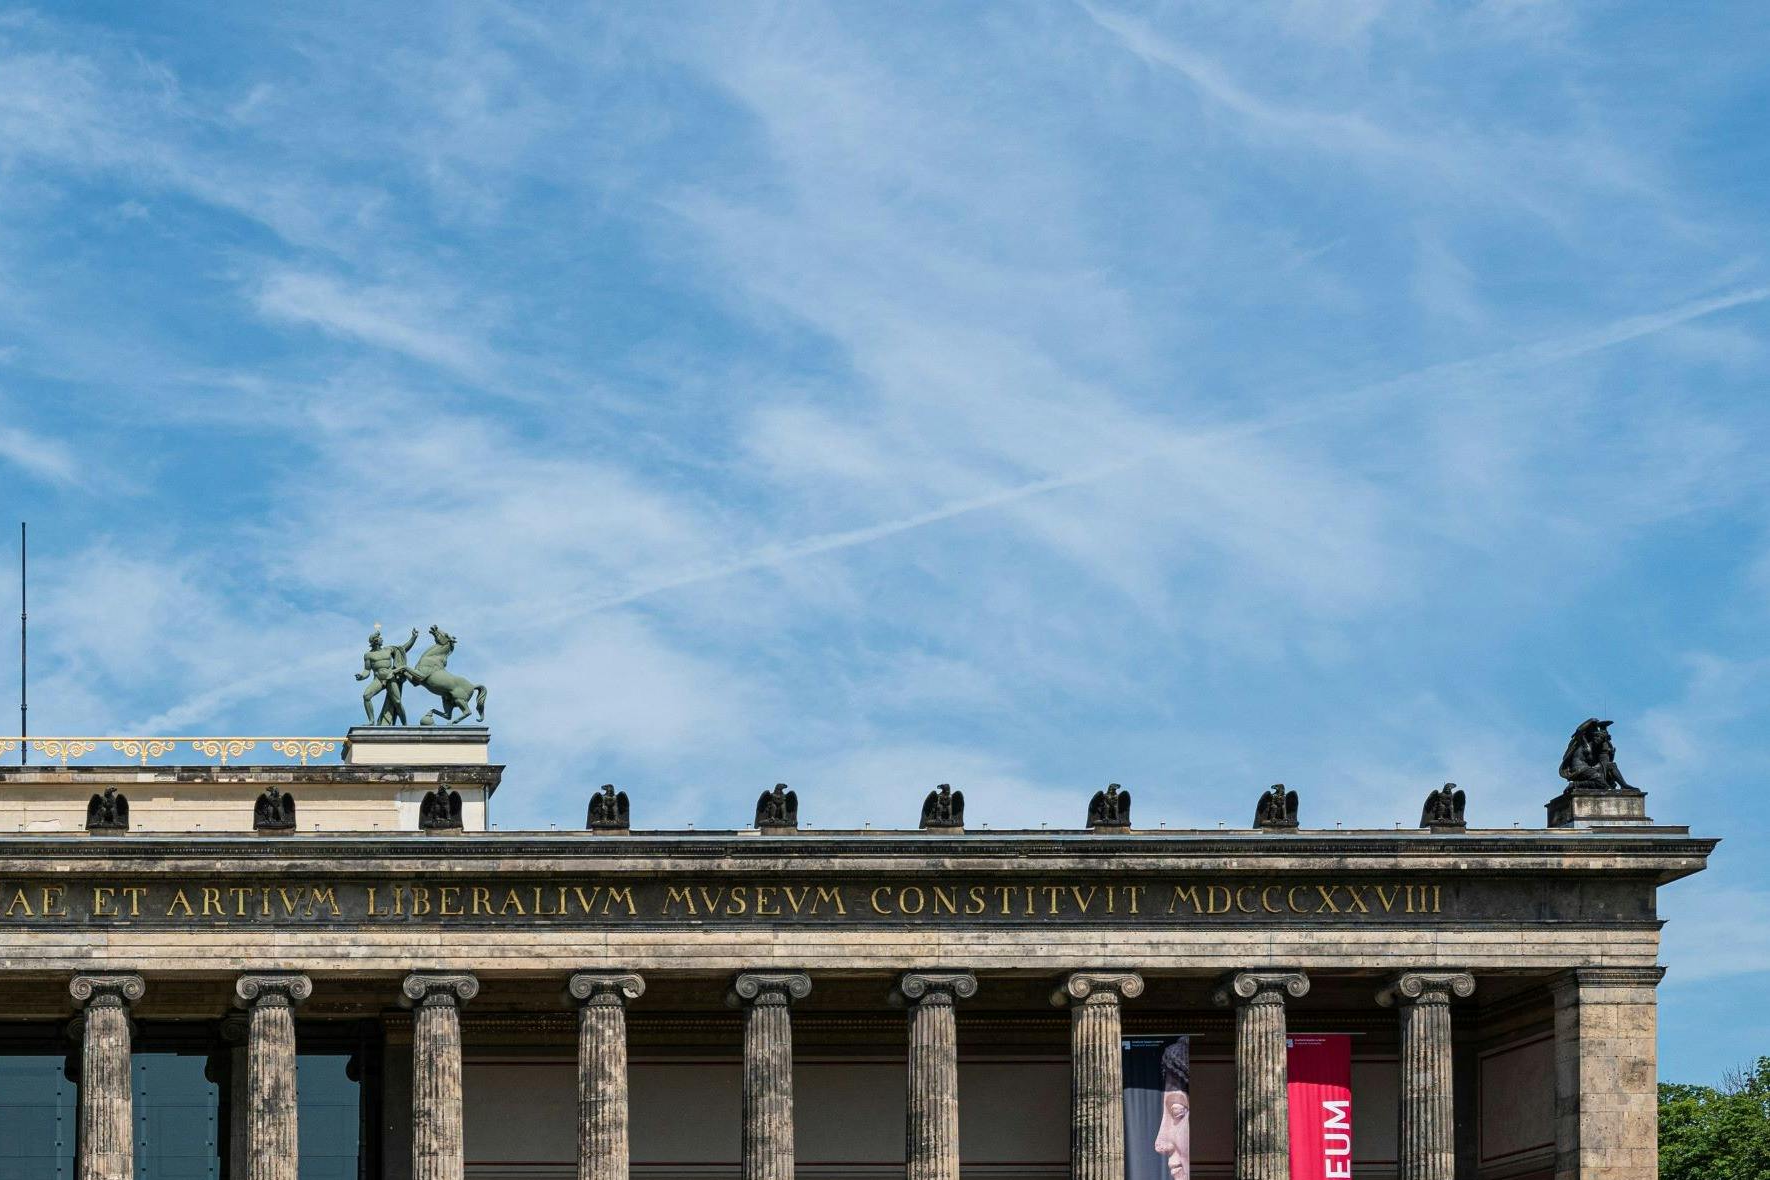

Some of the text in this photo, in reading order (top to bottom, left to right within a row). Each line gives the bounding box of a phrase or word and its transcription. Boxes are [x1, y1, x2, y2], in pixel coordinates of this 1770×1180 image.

[93, 886, 147, 915] ET
[166, 886, 341, 916] ARTIVM
[366, 886, 638, 916] LIBERALIVM
[661, 886, 847, 915] MVSEVM
[870, 885, 1146, 915] CONSTITVIT
[1168, 885, 1442, 913] MDCCCXXVIII
